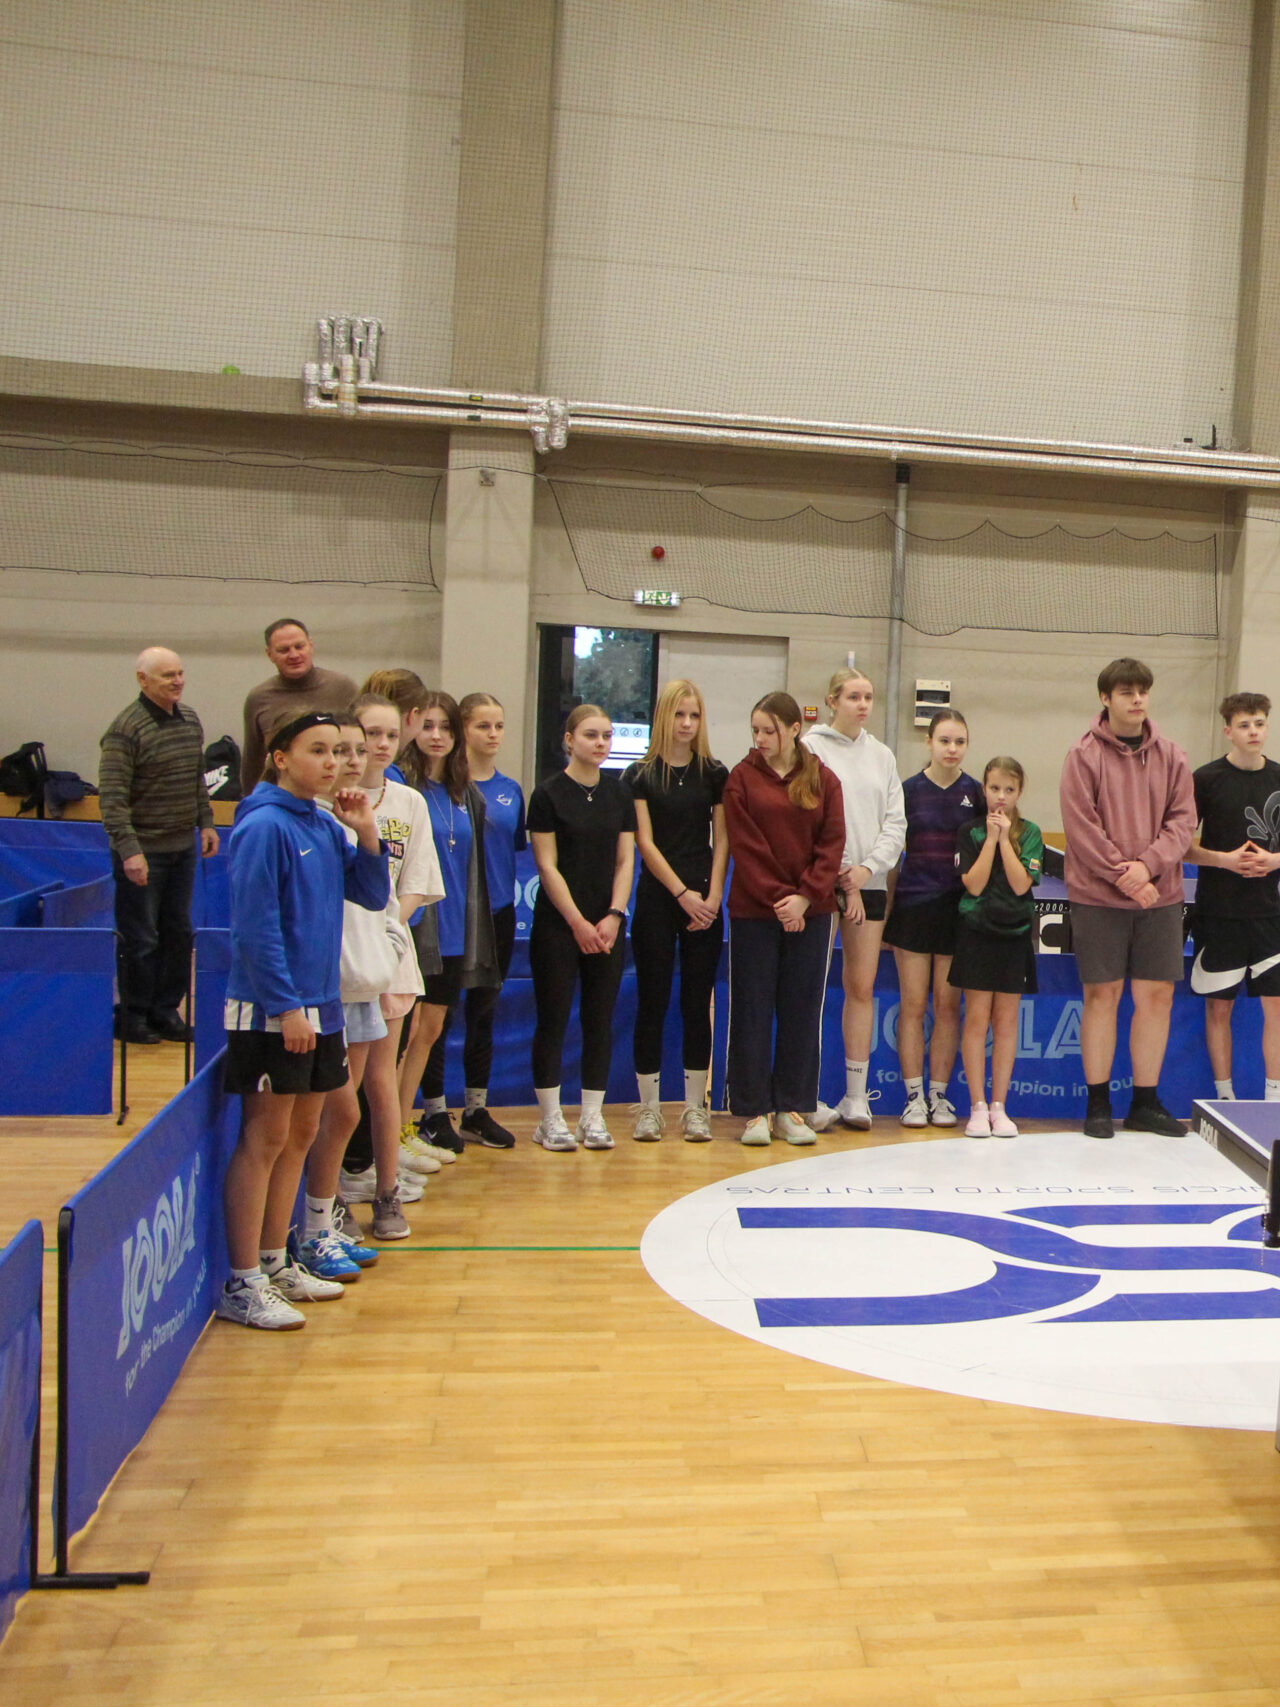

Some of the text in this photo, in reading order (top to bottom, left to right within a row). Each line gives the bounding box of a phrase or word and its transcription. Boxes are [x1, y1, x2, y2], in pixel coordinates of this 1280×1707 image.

[726, 1186, 935, 1195] CENTRAS
[954, 1186, 1135, 1195] SPORTO
[116, 1164, 197, 1361] JOOLA
[125, 1359, 141, 1398] for
[152, 1307, 186, 1352] Champion
